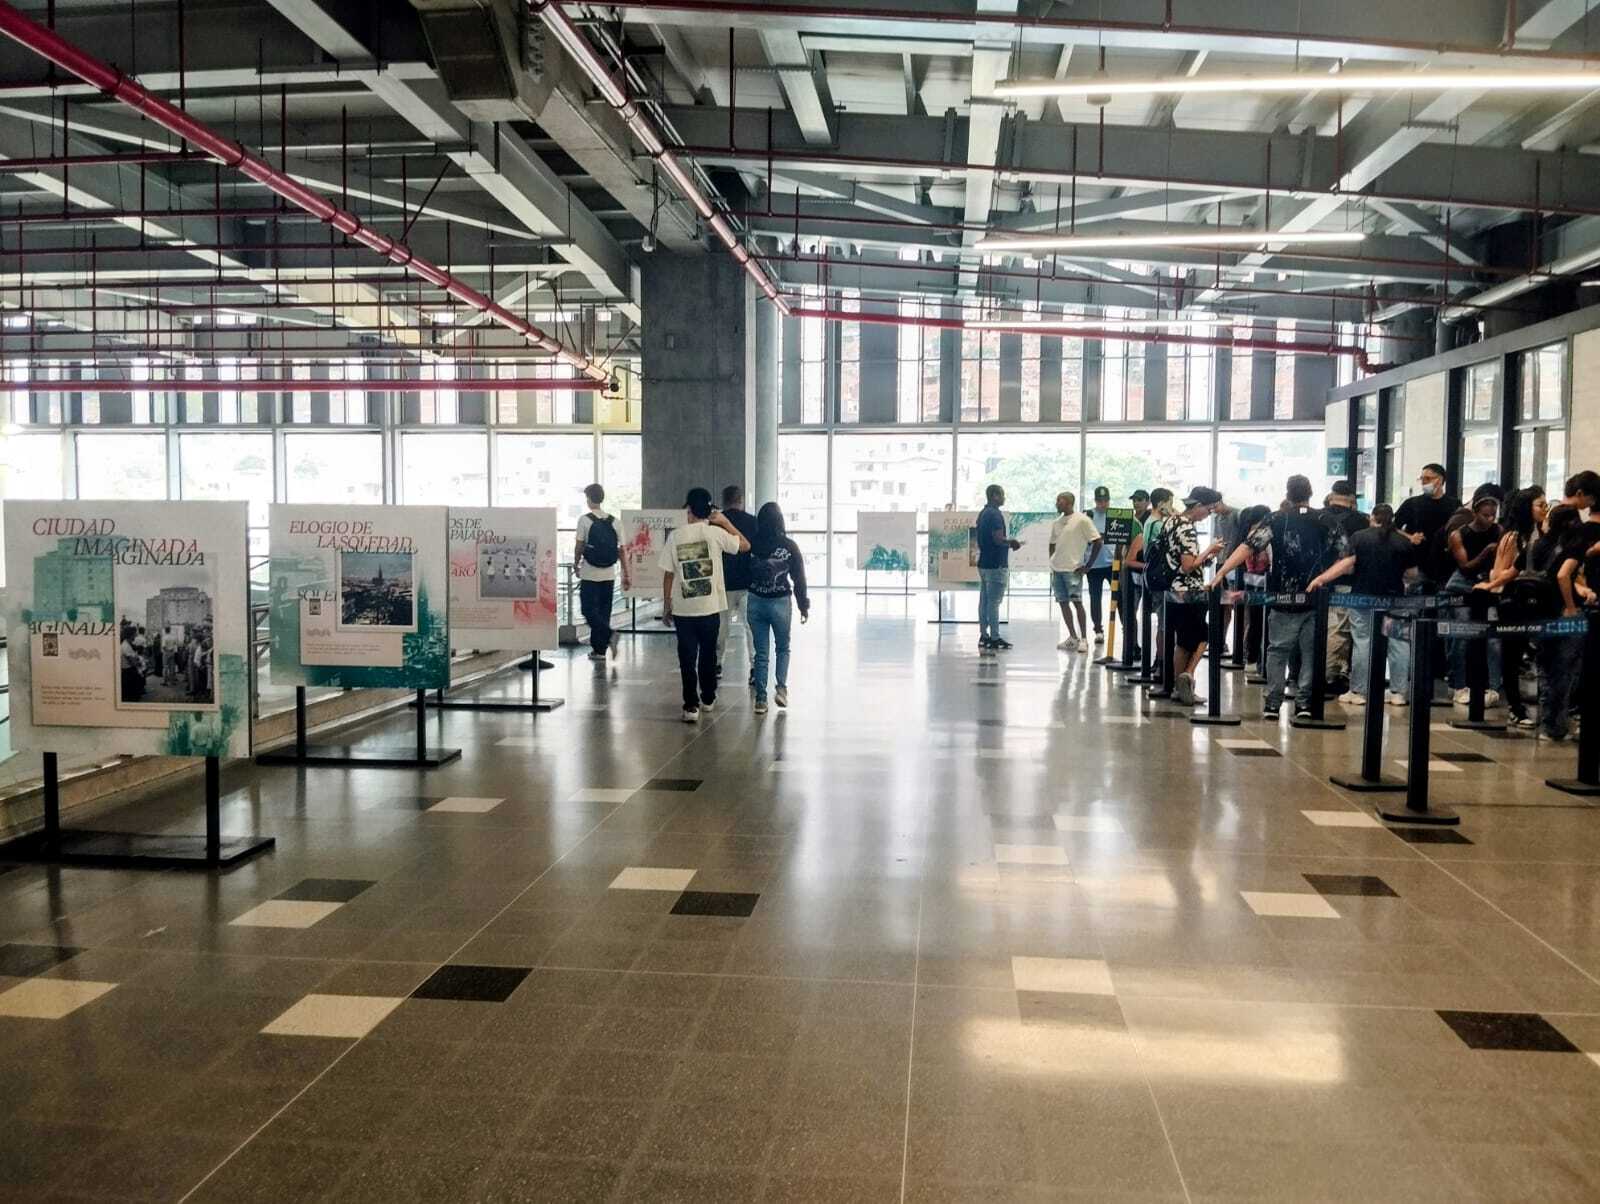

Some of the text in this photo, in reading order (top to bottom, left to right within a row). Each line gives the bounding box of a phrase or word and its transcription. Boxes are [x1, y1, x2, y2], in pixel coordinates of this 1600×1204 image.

[32, 518, 116, 536] CIUDAD
[289, 520, 374, 535] ELOGIO DE
[465, 518, 482, 529] DE
[73, 537, 199, 556] IMAGINADA
[317, 535, 336, 549] LA
